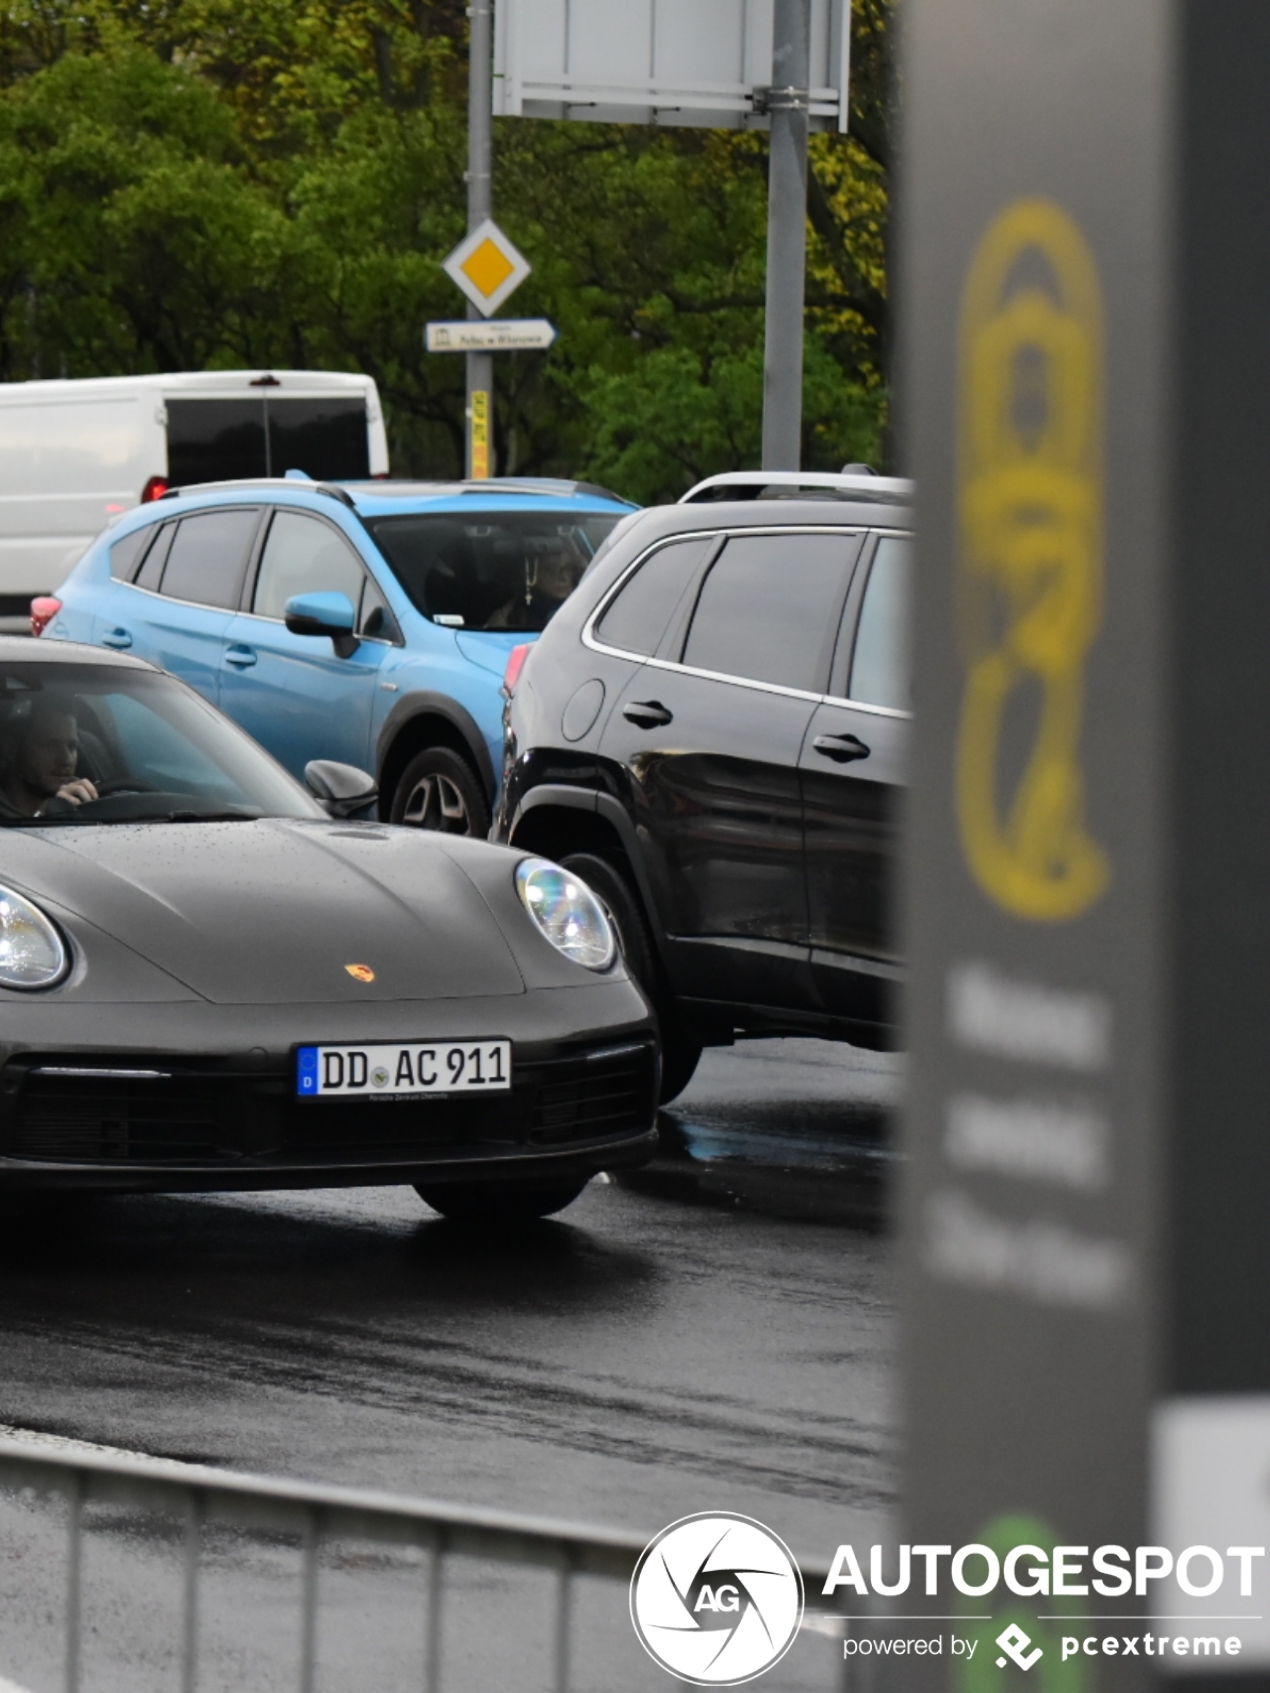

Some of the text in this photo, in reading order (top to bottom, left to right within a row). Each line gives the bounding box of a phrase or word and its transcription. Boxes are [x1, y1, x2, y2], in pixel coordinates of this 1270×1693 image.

[322, 1046, 506, 1089] DD AC 911
